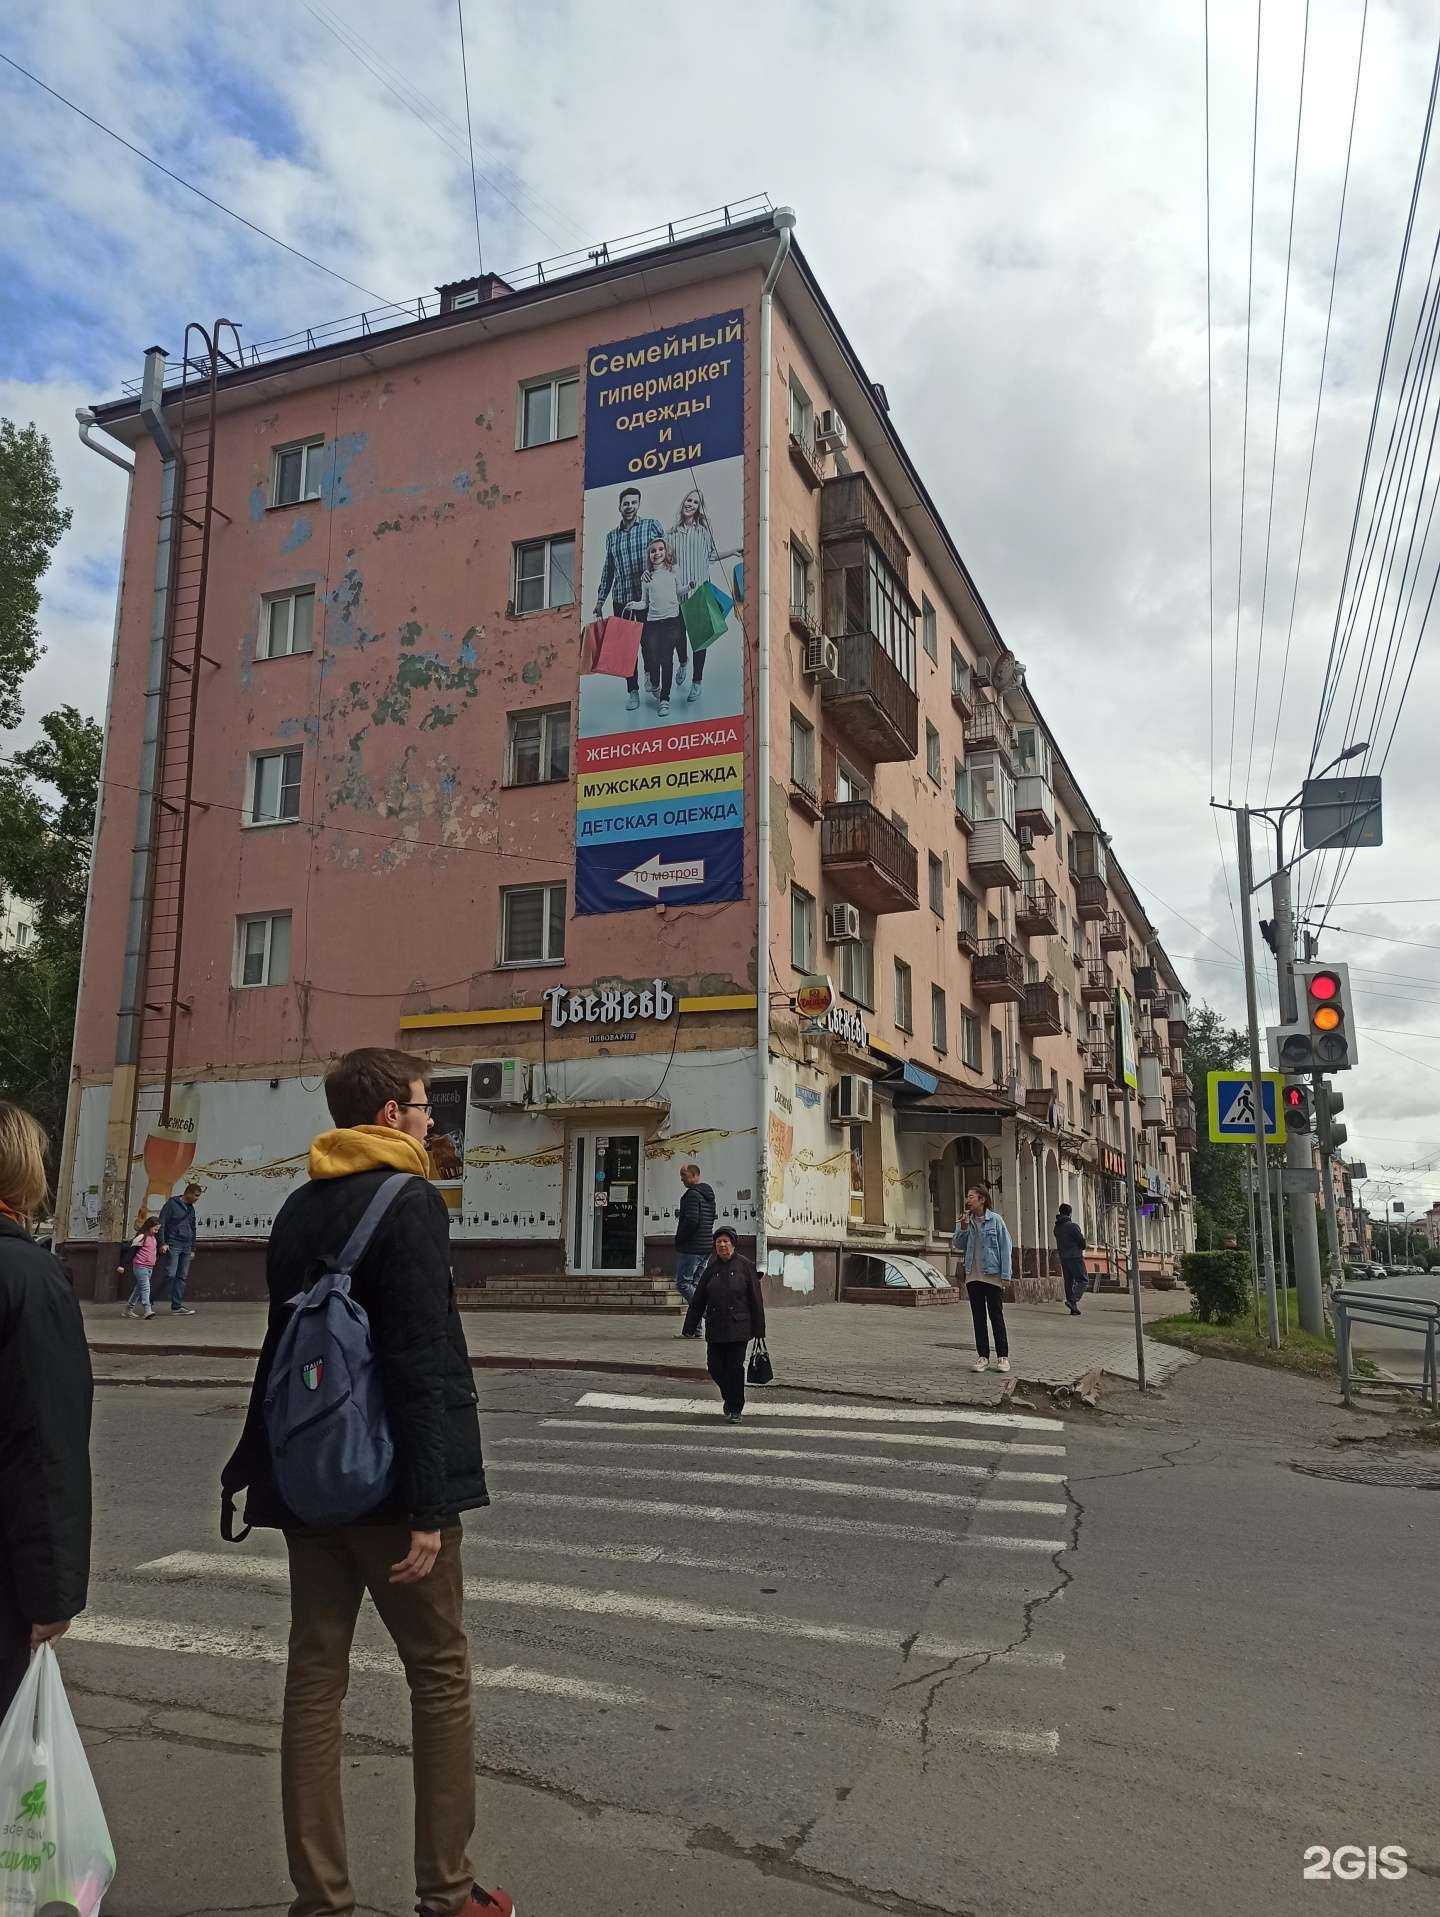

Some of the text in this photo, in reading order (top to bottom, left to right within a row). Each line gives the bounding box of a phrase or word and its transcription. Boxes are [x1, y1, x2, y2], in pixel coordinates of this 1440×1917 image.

[589, 318, 742, 377] Семейный
[599, 359, 732, 407] гипермаркет
[616, 395, 711, 431] одежды
[659, 428, 672, 443] и
[628, 443, 702, 473] обуви
[586, 728, 738, 762] ЖЕНСКАЯ ОДЕЖДА
[583, 766, 738, 798] МУЖСКАЯ ОДЕЖДА
[581, 803, 738, 837] ДЕТСКАЯ ОДЕЖДА
[633, 867, 699, 883] 10 метров
[303, 1358, 324, 1372] ITALIA
